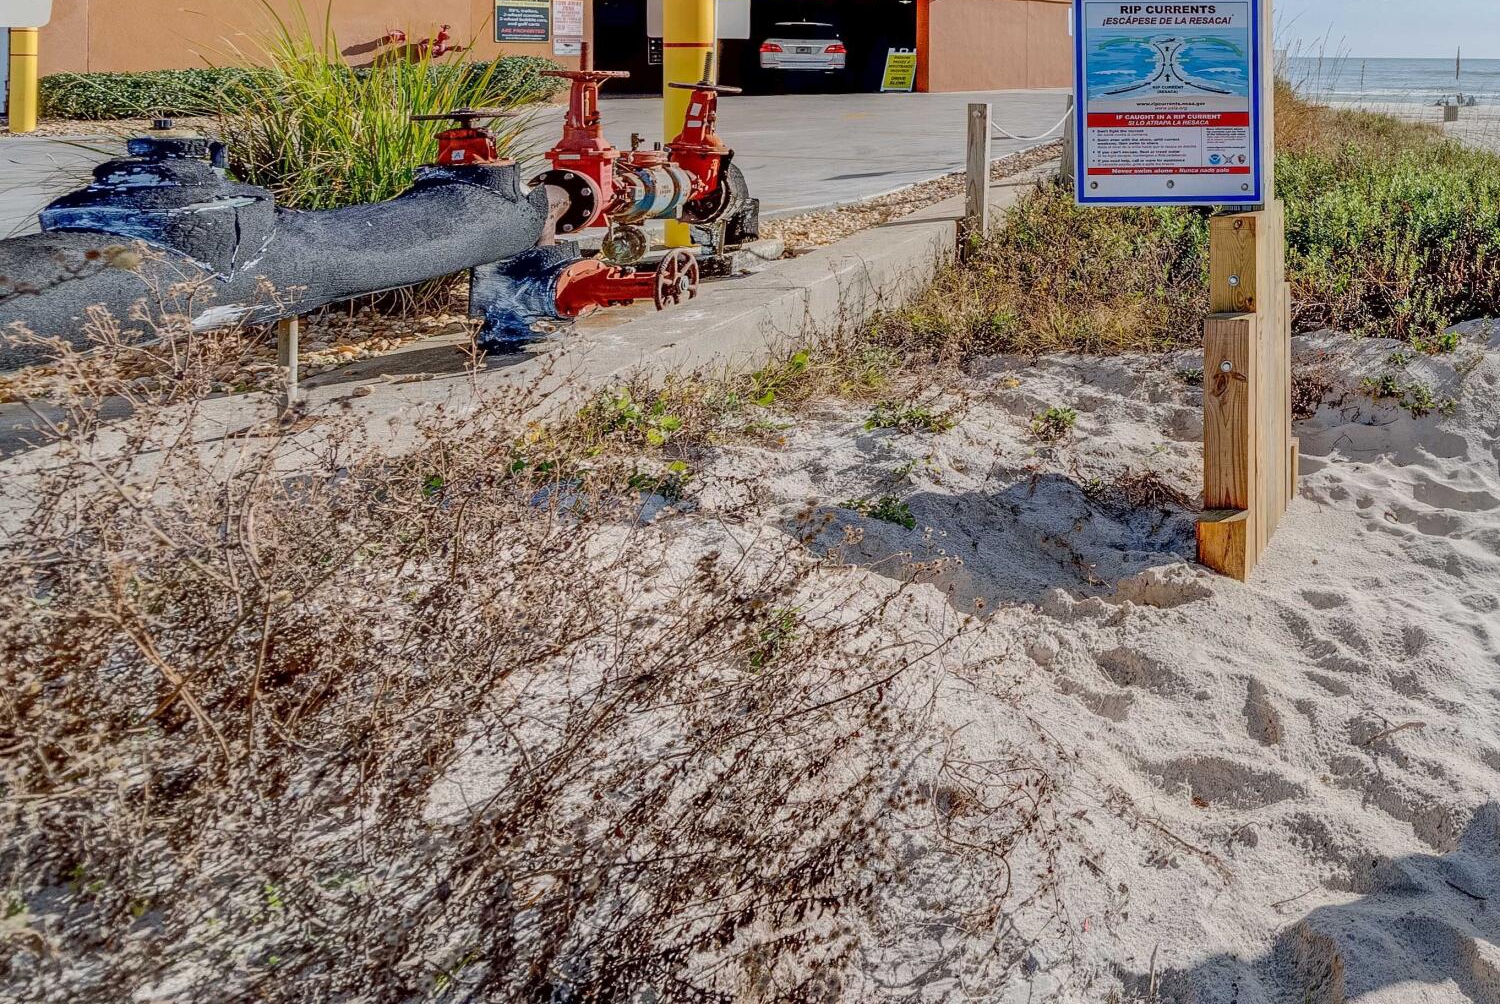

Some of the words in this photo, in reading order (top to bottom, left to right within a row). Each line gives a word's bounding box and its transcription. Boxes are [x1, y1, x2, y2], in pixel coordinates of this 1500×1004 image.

[1120, 5, 1141, 14] RIP
[1145, 5, 1217, 14] CURRENTS
[1157, 16, 1173, 25] DE
[1173, 16, 1188, 25] LA
